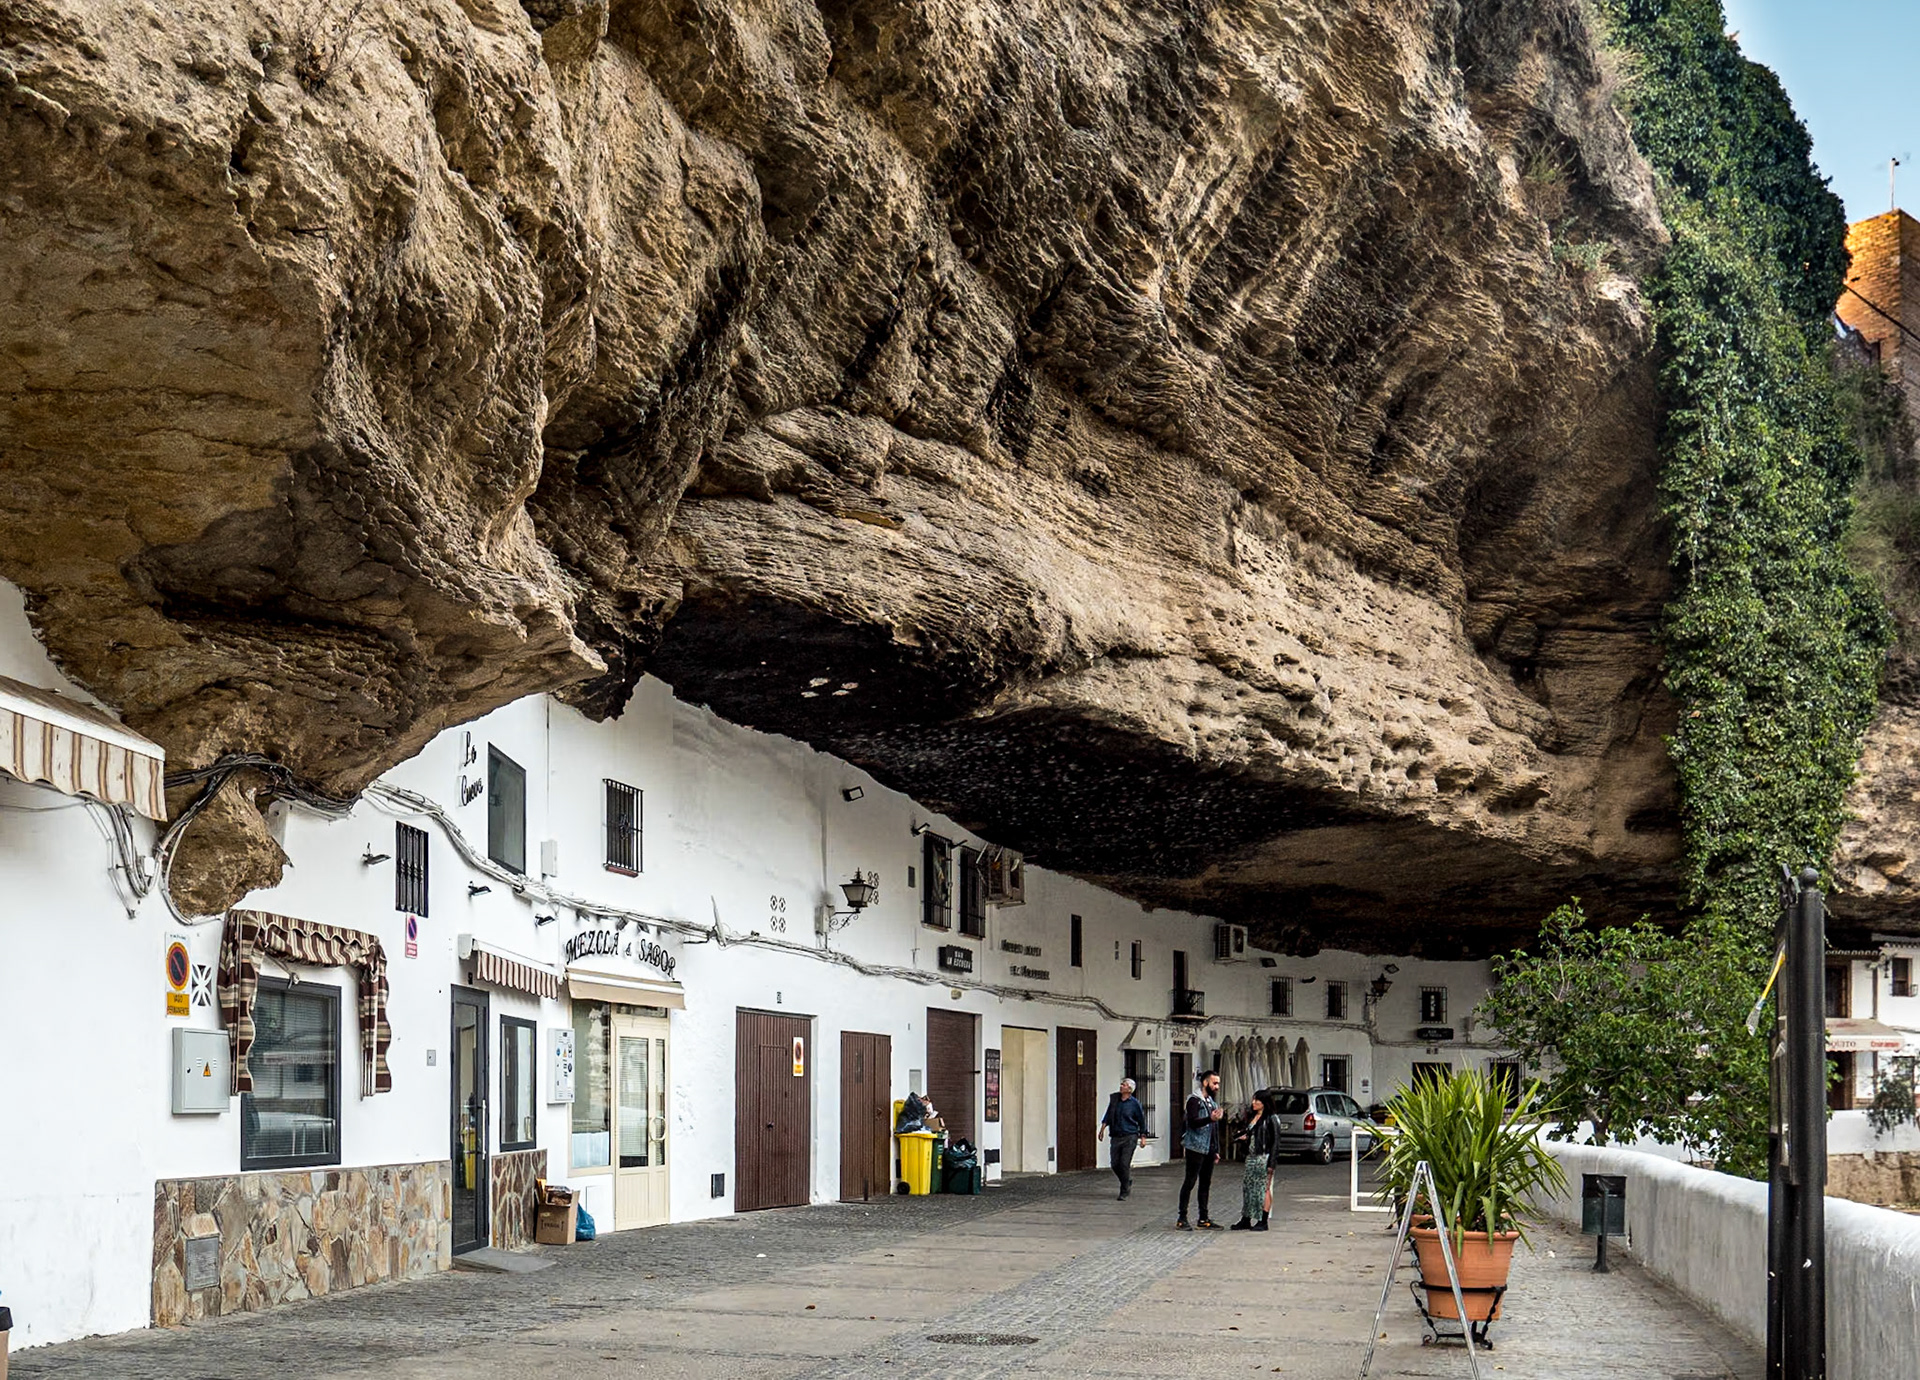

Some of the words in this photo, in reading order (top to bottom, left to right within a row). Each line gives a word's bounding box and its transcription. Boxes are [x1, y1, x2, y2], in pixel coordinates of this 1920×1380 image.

[463, 731, 477, 767] La
[461, 775, 484, 807] Cueva
[565, 930, 620, 966] MEZCLA
[638, 938, 677, 981] SABOR
